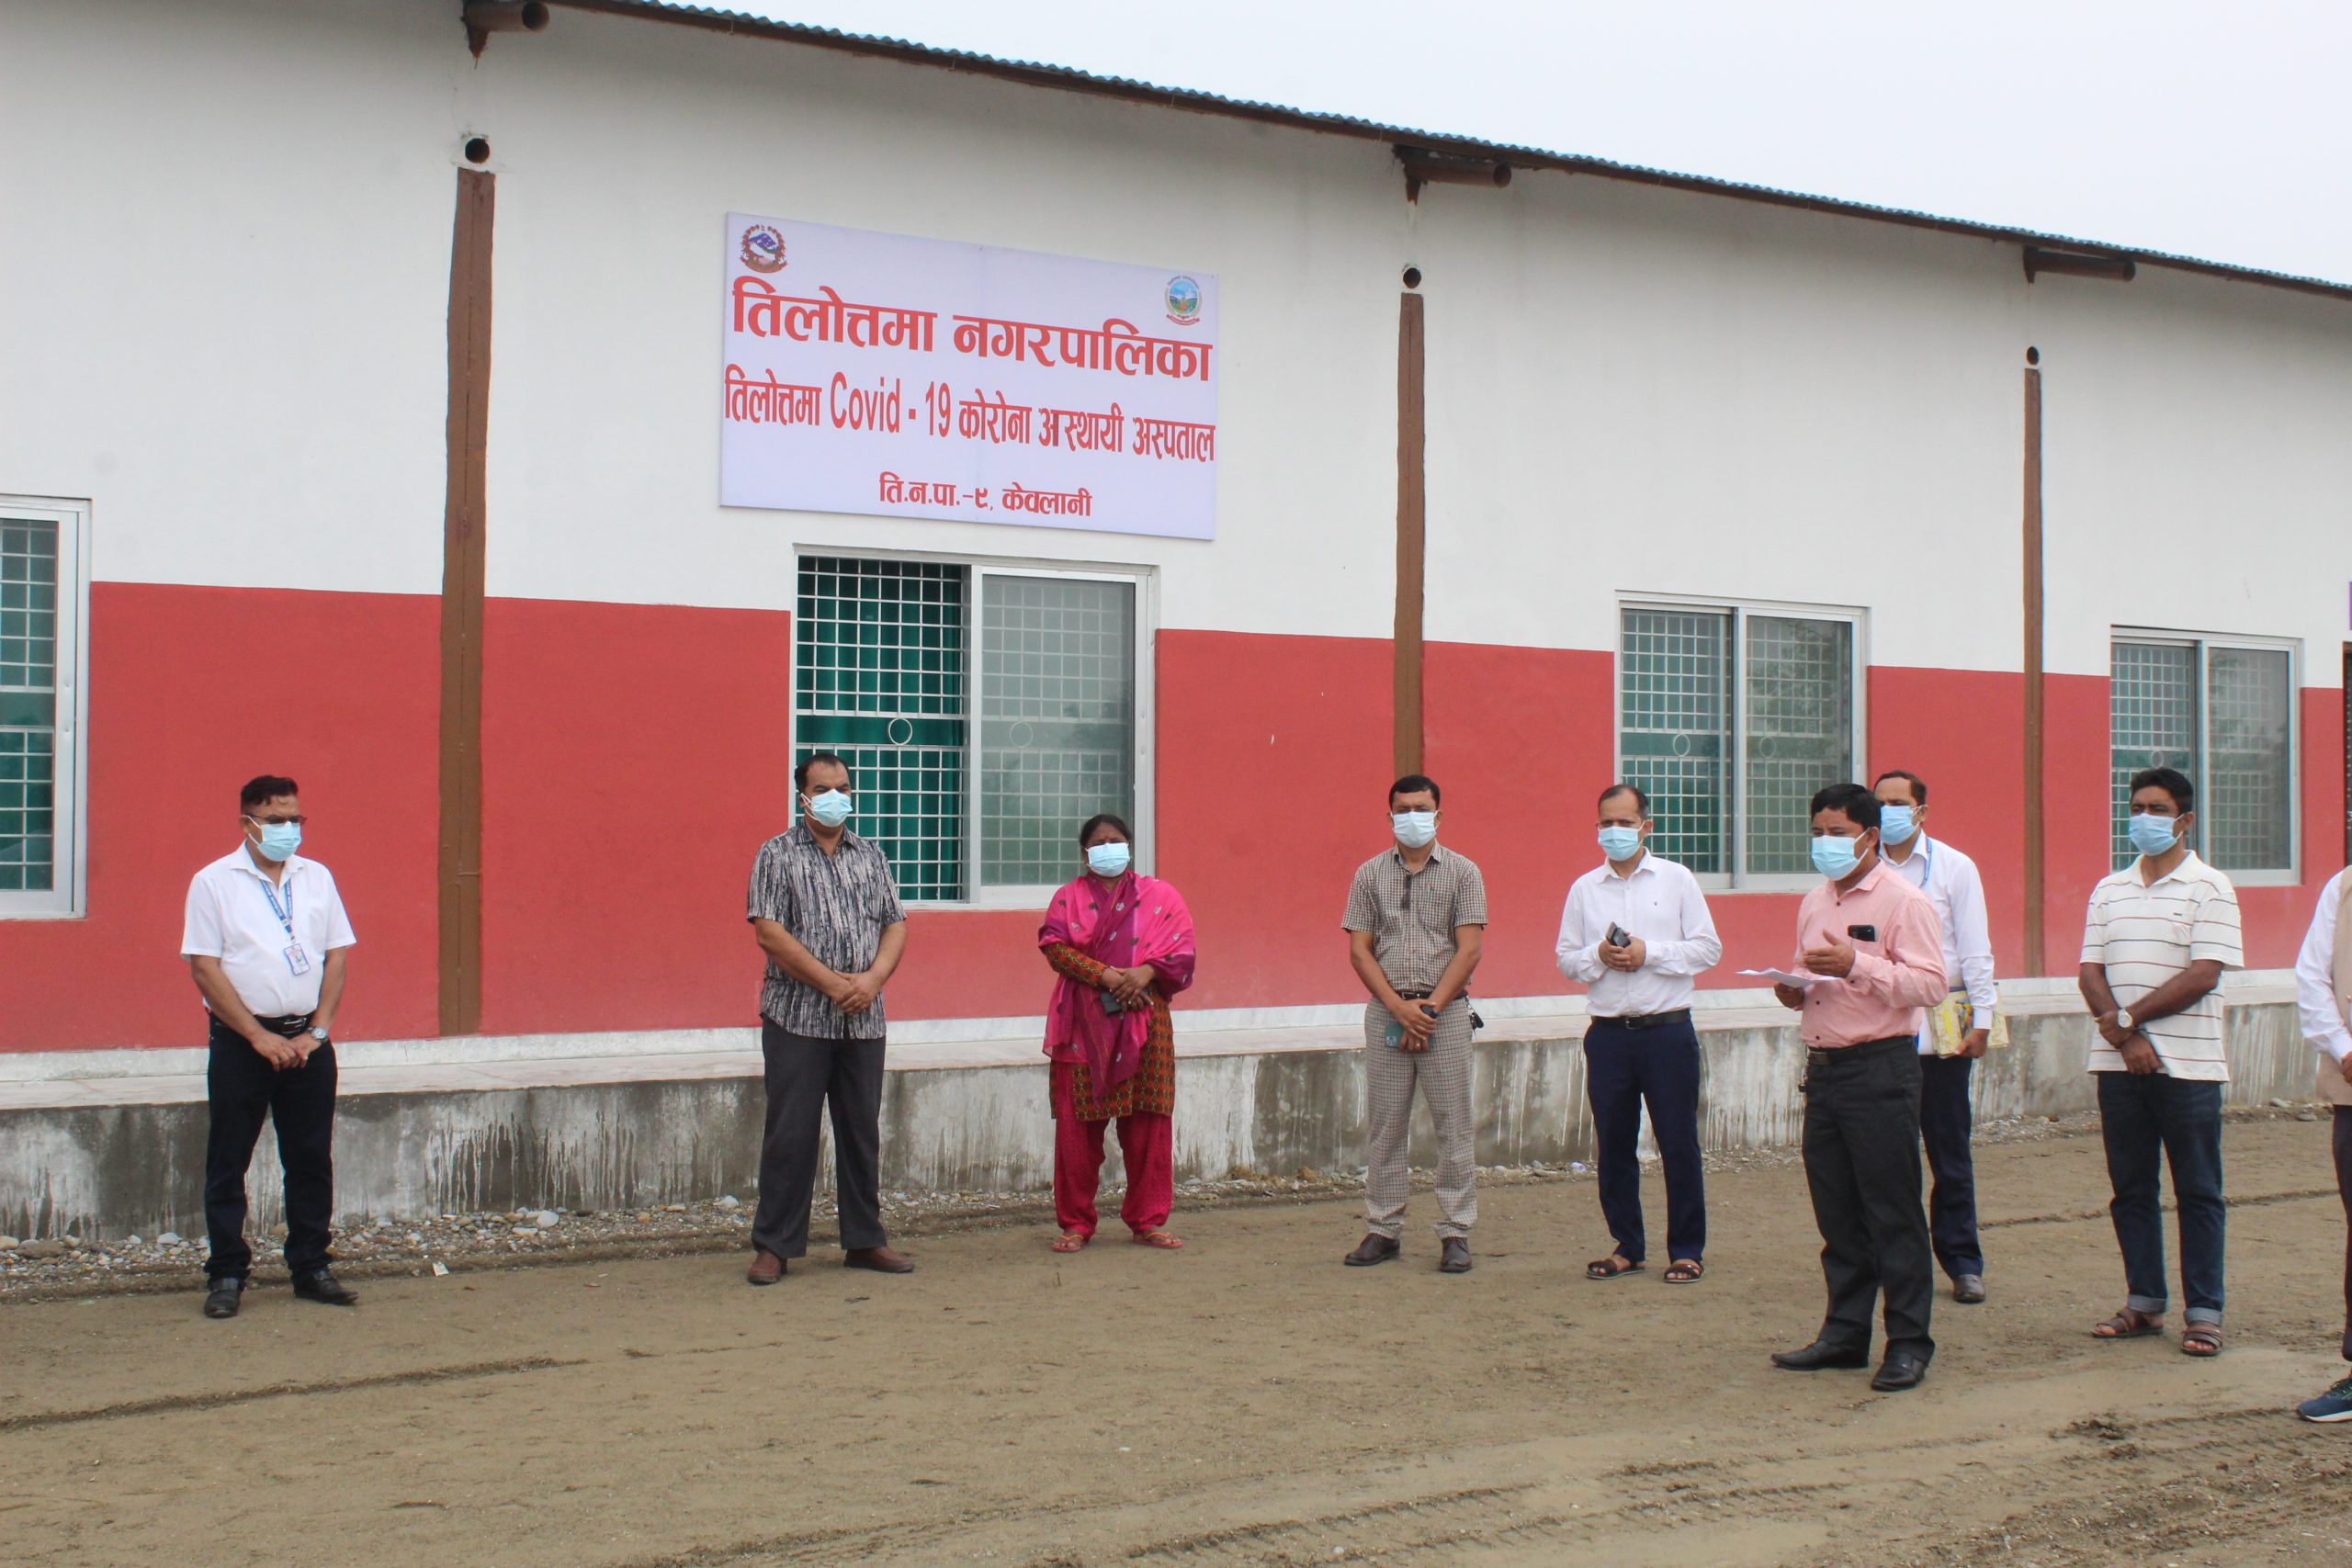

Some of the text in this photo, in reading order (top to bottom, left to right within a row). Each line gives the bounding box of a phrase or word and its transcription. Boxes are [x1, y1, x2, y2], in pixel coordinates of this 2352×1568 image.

[732, 276, 1214, 382] तिलोत्तमा नगरपालिका
[724, 363, 823, 427] तिलोत्तमा
[830, 371, 901, 434] Covid
[925, 382, 952, 438] 19
[958, 388, 1033, 444] कोरोना
[1132, 416, 1216, 463] अस्पताल
